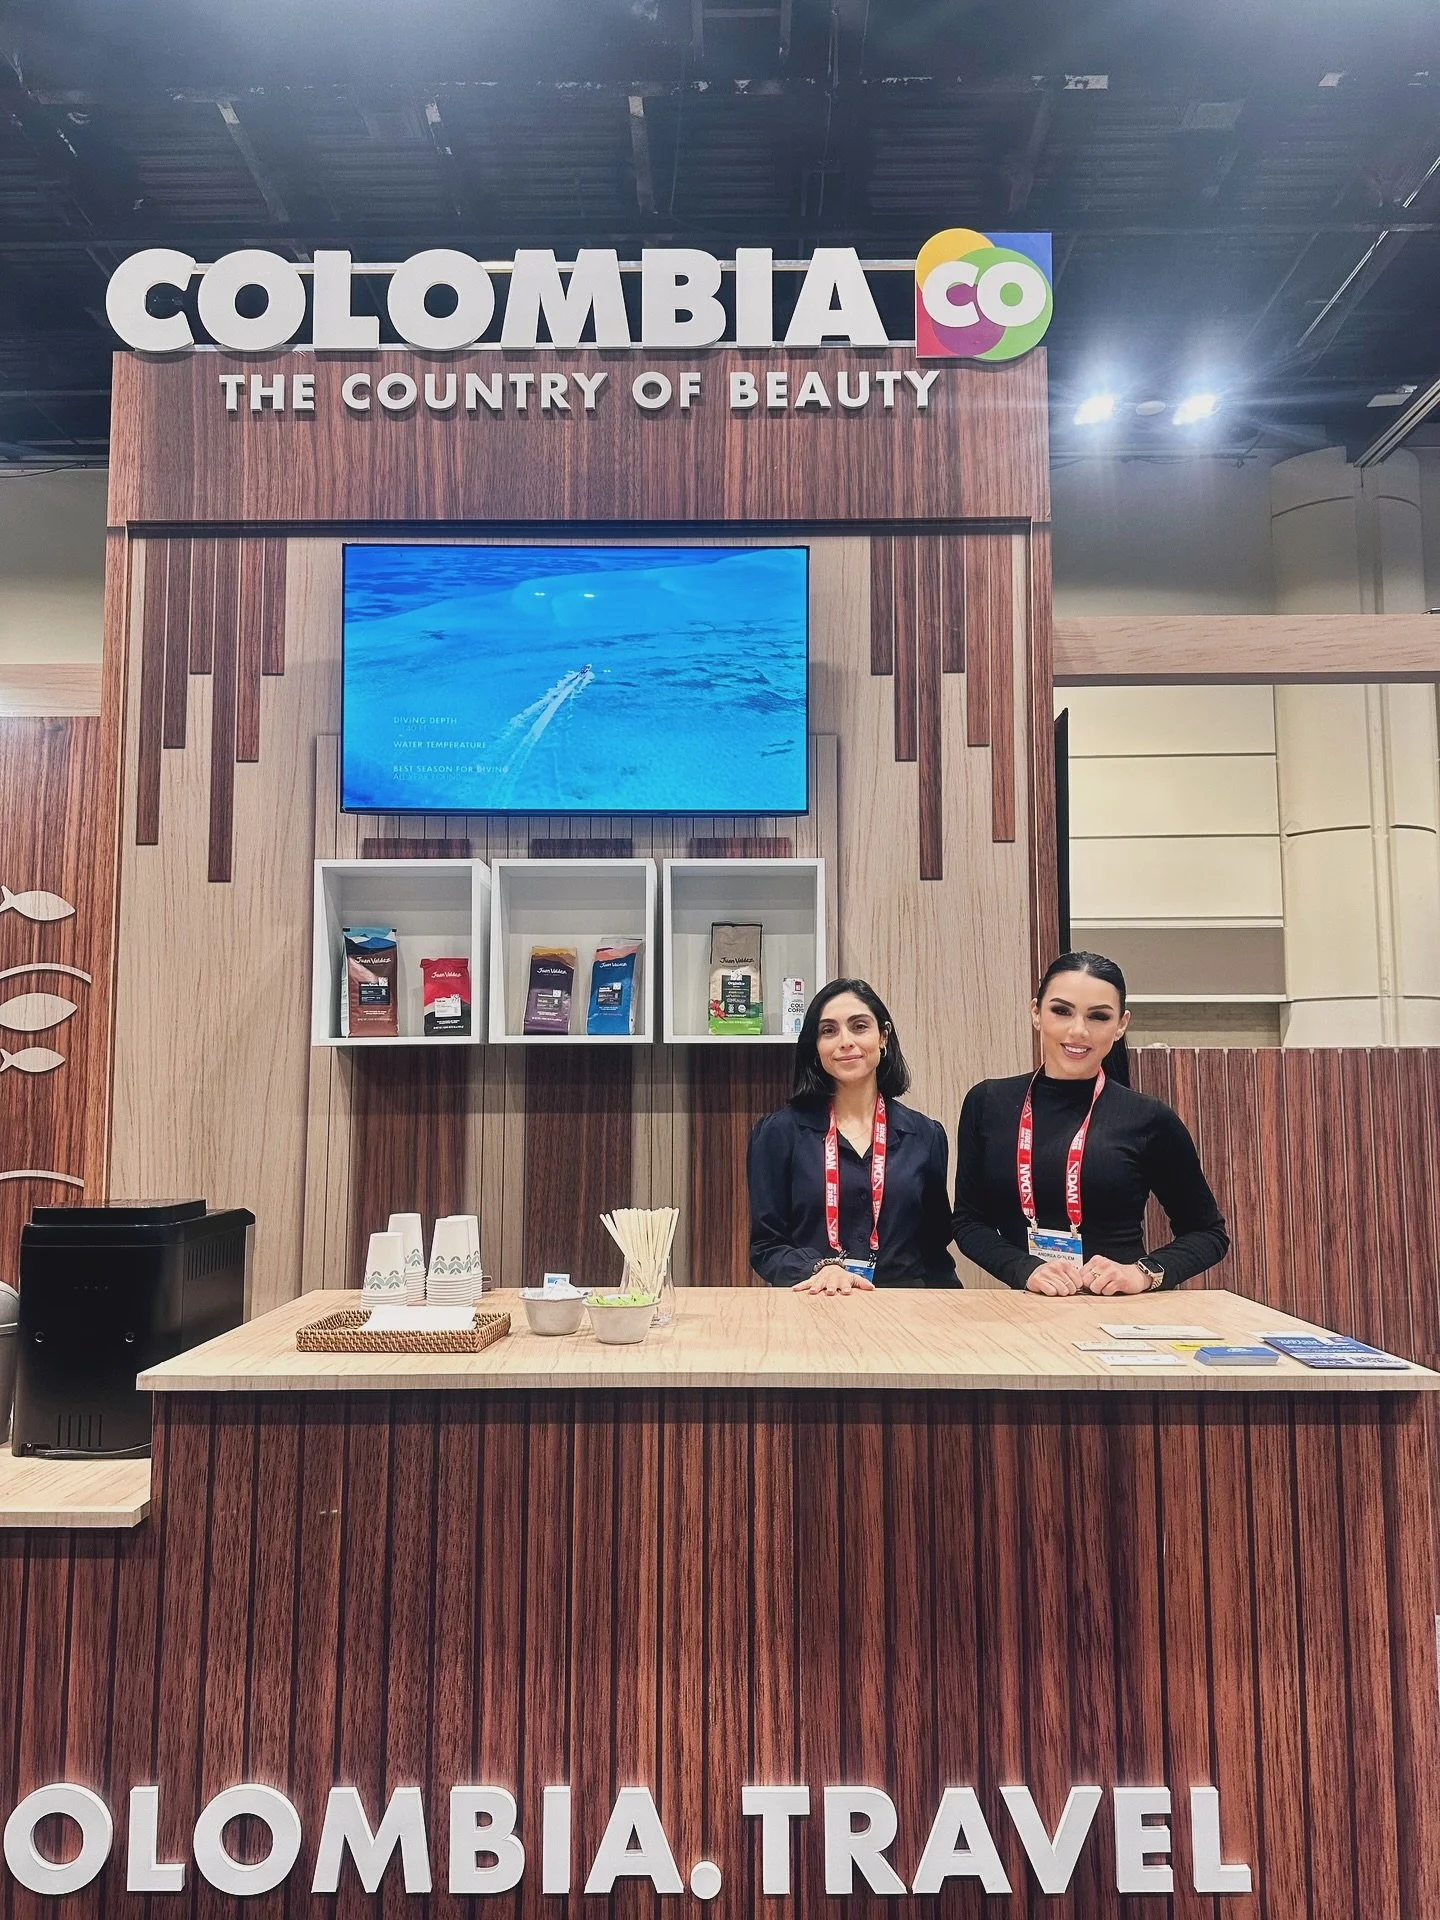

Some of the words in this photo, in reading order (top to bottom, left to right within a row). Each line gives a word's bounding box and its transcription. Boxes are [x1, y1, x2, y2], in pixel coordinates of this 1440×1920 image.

[106, 248, 889, 352] COLOMBIA
[922, 260, 1047, 327] CO
[219, 373, 315, 411] THE
[341, 372, 608, 411] COUNTRY
[632, 371, 701, 410] OF
[730, 370, 940, 410] BEAUTY
[393, 716, 427, 725] DIVING
[429, 716, 458, 725] DEPTH
[393, 741, 423, 749] WATER
[426, 741, 486, 749] TEMPERATURE
[393, 765, 413, 773] BEST
[416, 765, 453, 773] SEASON
[456, 765, 473, 773] FOR
[476, 764, 509, 773] DIVING
[826, 1146, 836, 1170] DAN
[873, 1155, 884, 1181] DAN
[1020, 1163, 1031, 1193] DAN
[1067, 1174, 1079, 1204] DAN
